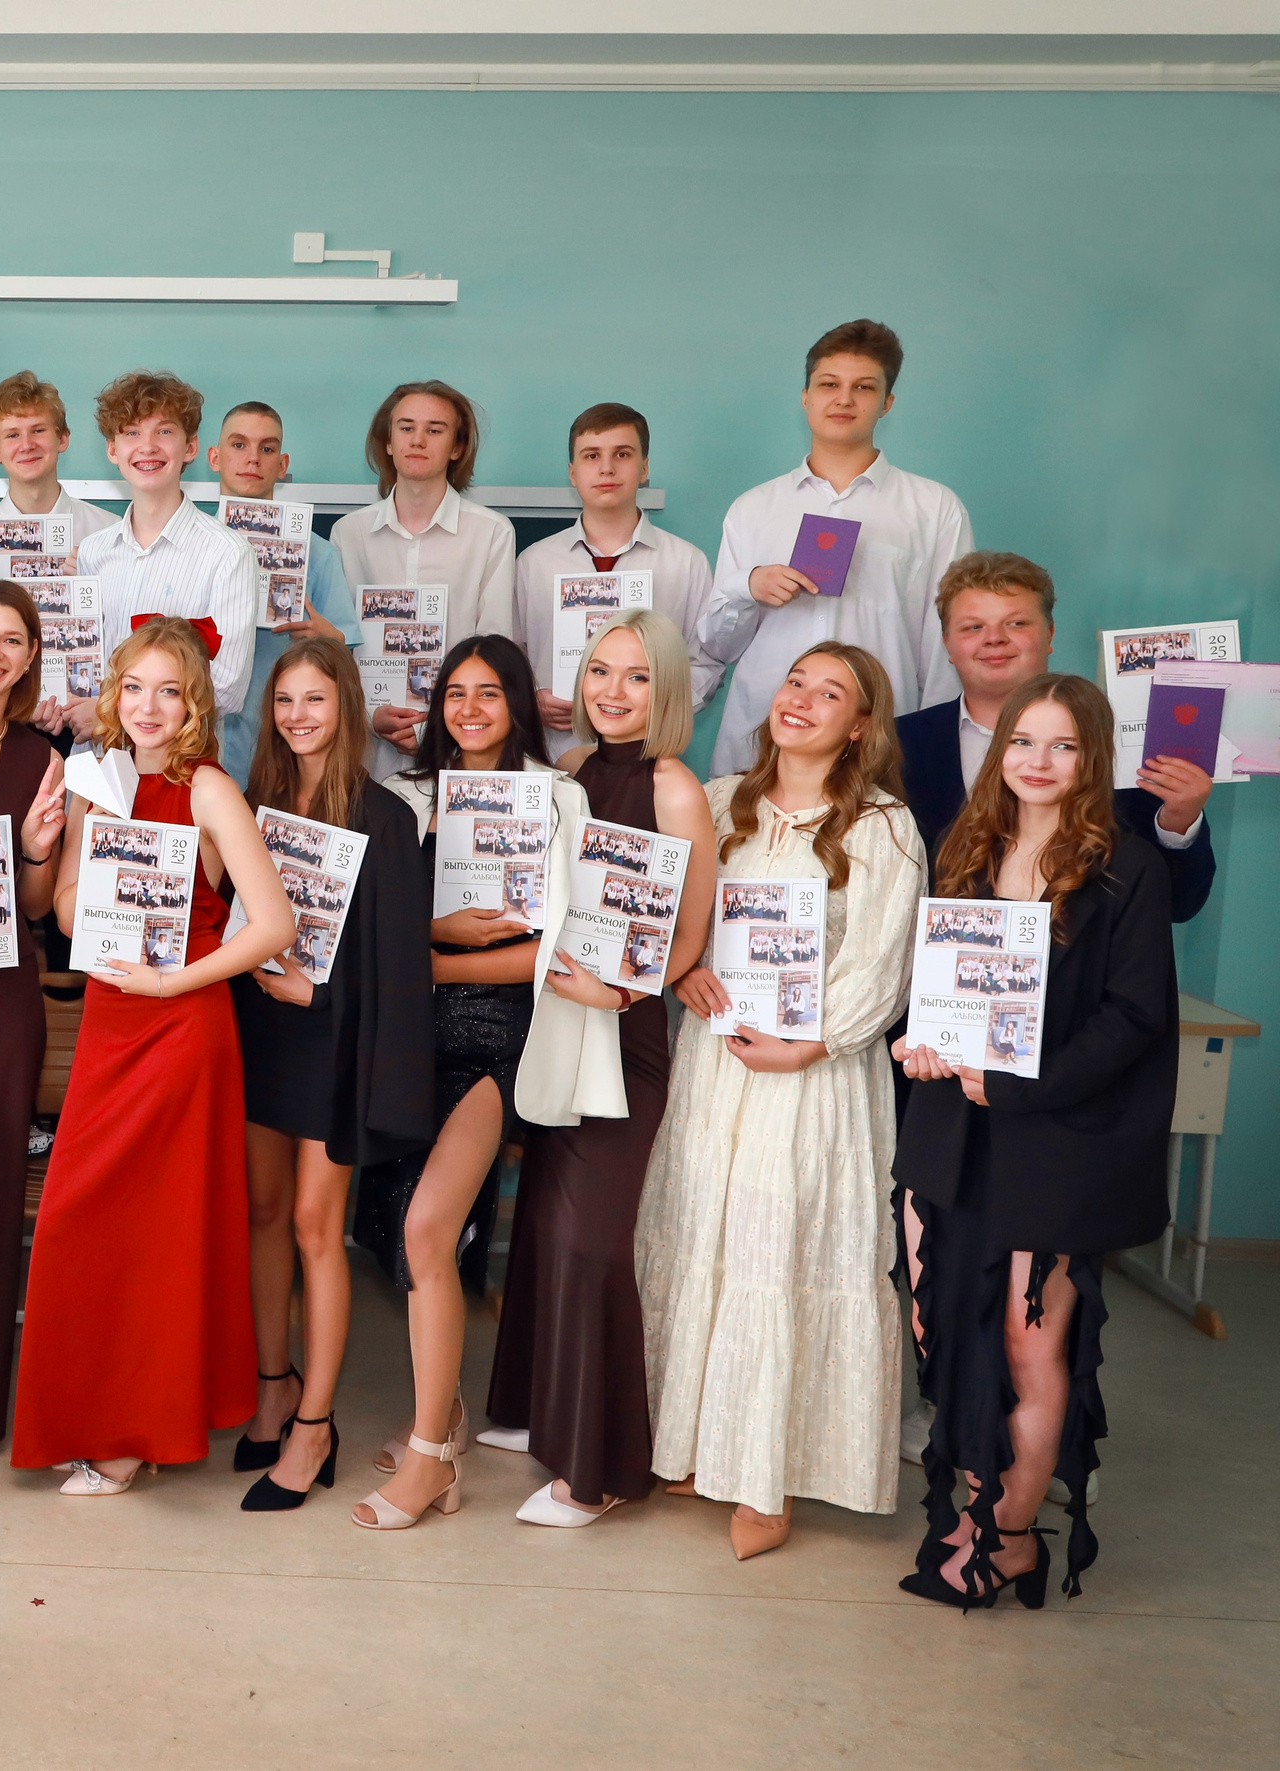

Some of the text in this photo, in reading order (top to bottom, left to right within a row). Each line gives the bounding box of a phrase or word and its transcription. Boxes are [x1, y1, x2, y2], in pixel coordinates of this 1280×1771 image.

[291, 522, 302, 531] 25
[53, 535, 65, 545] 25
[80, 587, 93, 595] 20
[631, 589, 643, 599] 25
[80, 596, 93, 607] 25
[427, 604, 438, 613] 25
[1208, 634, 1227, 645] 20
[1210, 645, 1227, 658] 25
[374, 683, 388, 694] 9А
[525, 785, 541, 794] 20
[525, 795, 540, 807] 25
[172, 839, 187, 849] 20
[339, 843, 354, 854] 20
[171, 850, 185, 862] 25
[663, 849, 678, 859] 20
[335, 853, 350, 867] 25
[444, 861, 501, 872] ВЫПУСКНОЙ
[661, 859, 676, 873] 25
[471, 873, 501, 881] АЛЬБОМ
[462, 891, 480, 905] 9А
[799, 891, 814, 900] 20
[799, 902, 813, 914] 25
[84, 908, 142, 923] ВЫПУСКНОЙ
[568, 909, 627, 930] ВЫПУСКНОЙ
[1019, 915, 1037, 925] 20
[111, 922, 141, 932] АЛЬБОМ
[593, 926, 625, 939] АЛЬБОМ
[1019, 927, 1035, 941] 25
[0, 943, 9, 952] 25
[101, 940, 119, 954] 9А
[581, 942, 600, 956] 9А
[721, 971, 776, 981] ВЫПУСКНОЙ
[738, 1001, 755, 1015] 9А
[920, 998, 986, 1011] ВЫПУСКНОЙ
[951, 1012, 986, 1022] АЛЬБОМ
[940, 1031, 960, 1046] 9А
